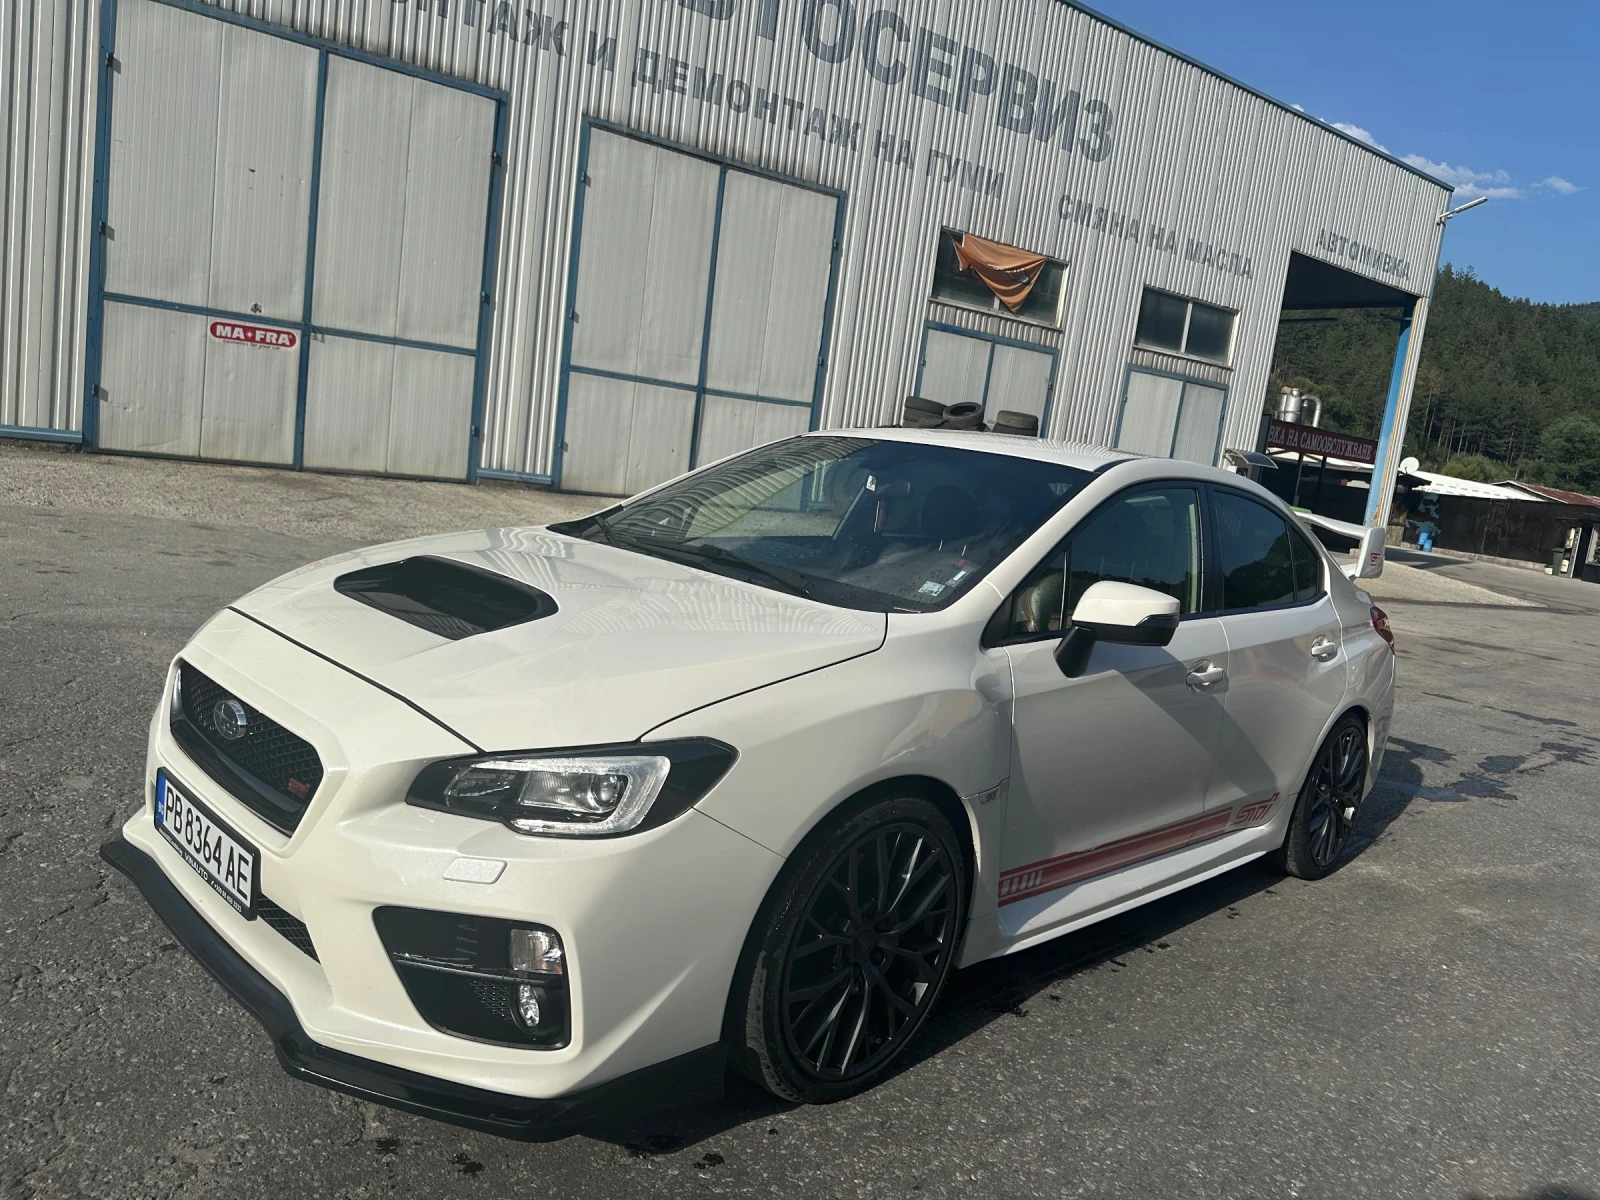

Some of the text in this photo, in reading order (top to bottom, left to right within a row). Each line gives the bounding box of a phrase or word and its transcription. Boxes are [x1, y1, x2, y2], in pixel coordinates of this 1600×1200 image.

[587, 30, 617, 72] И
[631, 47, 862, 152] ДЕМОНТАЖ
[873, 129, 914, 170] НА
[927, 148, 1005, 199] ГУМИ
[1058, 194, 1251, 280] СМЯНА НА МАСЛА
[1315, 228, 1410, 280] АВТОМИВКА
[1286, 428, 1298, 447] НА
[1300, 432, 1373, 460] САМООБСЛУЖВАНЕ
